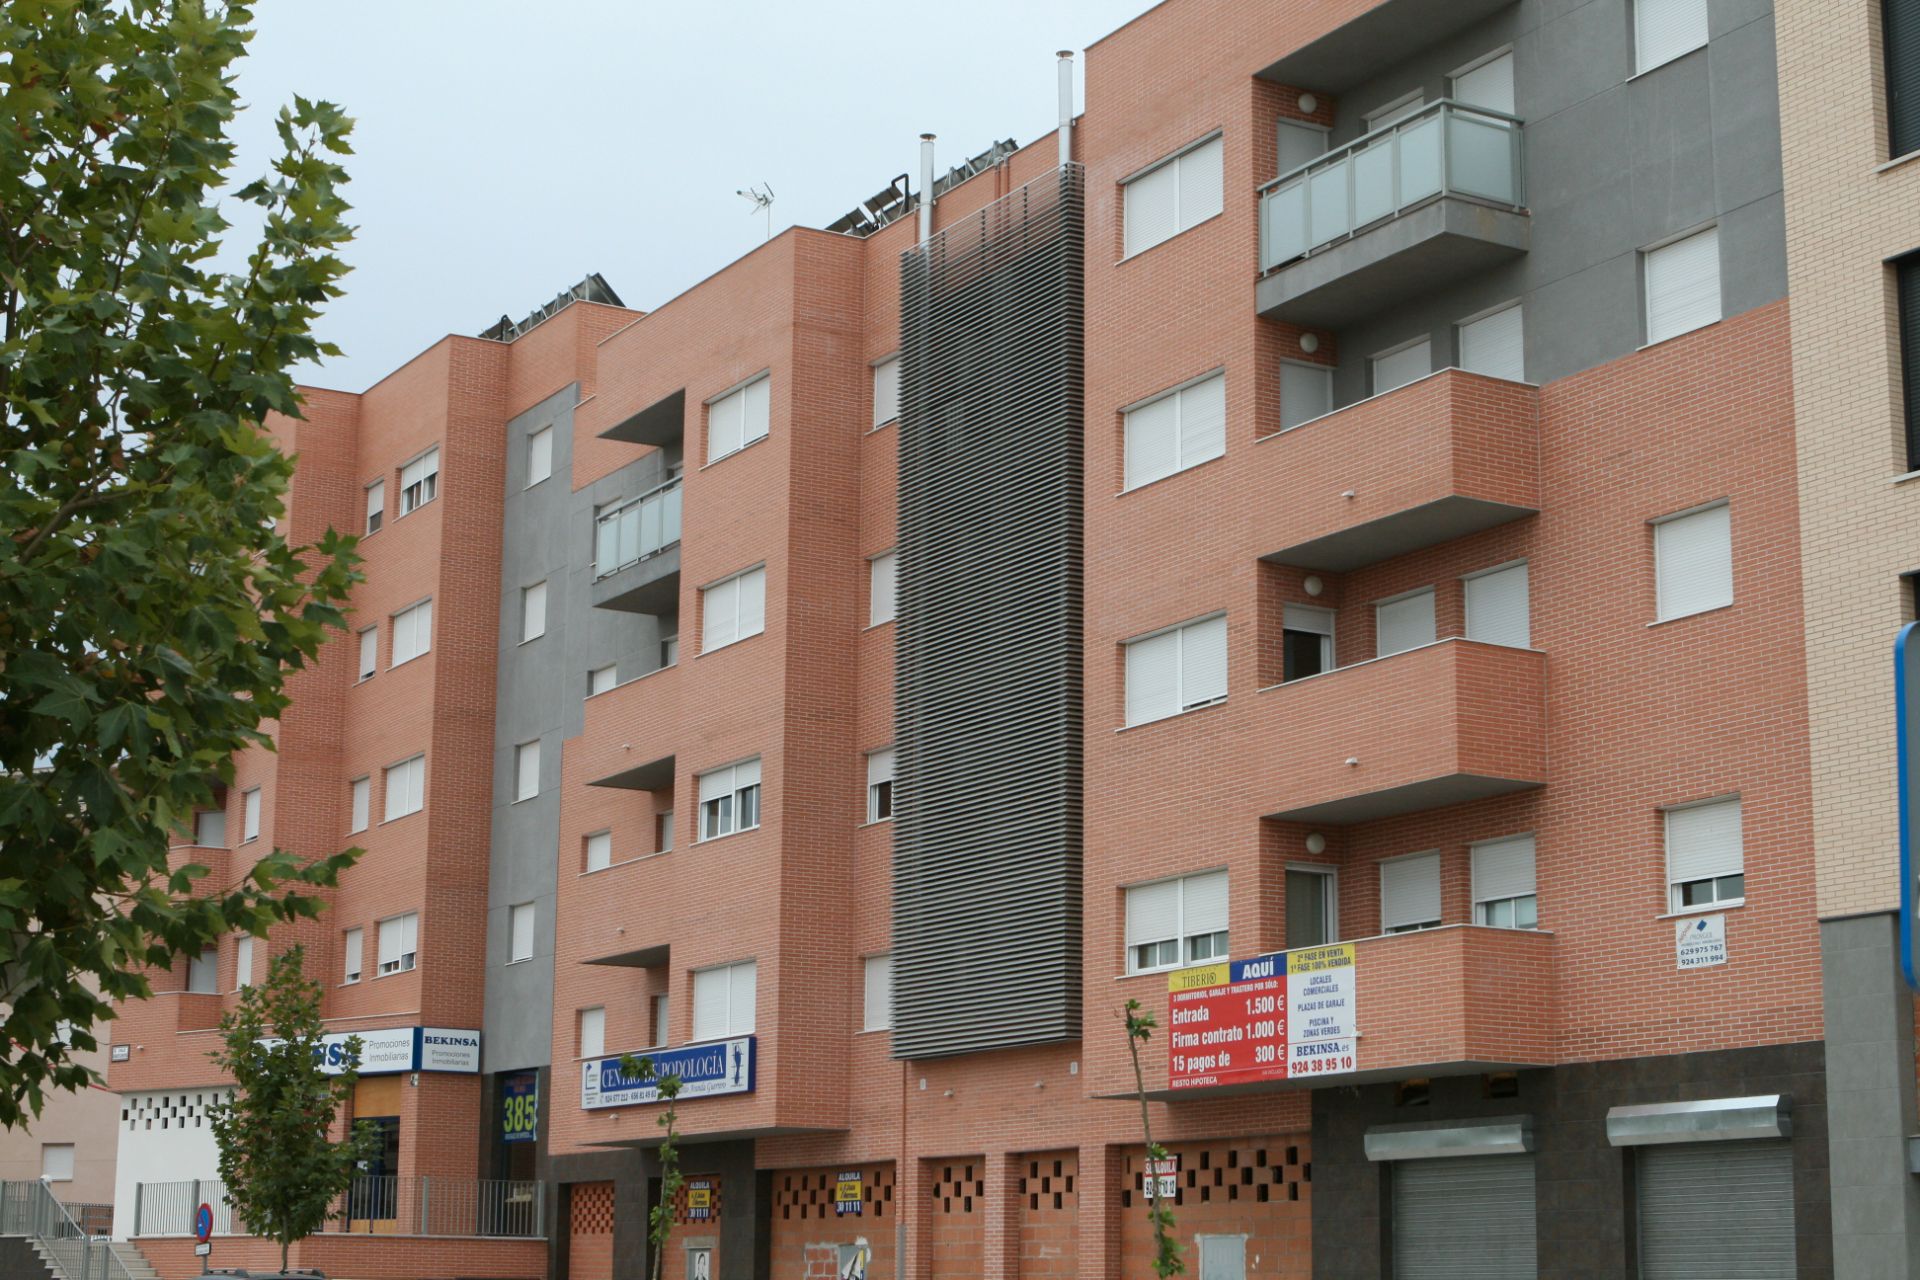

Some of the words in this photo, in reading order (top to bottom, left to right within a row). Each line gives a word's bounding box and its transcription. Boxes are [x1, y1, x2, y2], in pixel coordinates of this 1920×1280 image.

[1304, 950, 1317, 961] FASE
[1318, 950, 1326, 960] EN
[1326, 947, 1344, 959] VENTA
[1242, 957, 1274, 979] AQUÍ
[1297, 962, 1310, 973] FASE
[1311, 960, 1327, 971] 100%
[1327, 956, 1351, 968] VENDIDA
[1310, 974, 1332, 986] LOCALES
[1210, 987, 1226, 998] GARAJE
[1231, 983, 1254, 994] TRASTERO
[1254, 982, 1264, 991] POR
[1303, 984, 1339, 996] COMERCIALES
[1172, 1005, 1209, 1025] Entrada
[1246, 996, 1275, 1015] 1.500
[1277, 994, 1285, 1011] €
[1297, 1001, 1317, 1012] PLAZAS
[1317, 1000, 1324, 1010] DE
[1325, 998, 1345, 1009] GARAJE
[1309, 1017, 1329, 1027] PISCINA
[1330, 1016, 1334, 1024] Y
[1172, 1031, 1199, 1049] Firma
[1202, 1025, 1243, 1045] contrato
[1246, 1020, 1275, 1040] 1.000
[1277, 1019, 1285, 1036] €
[1303, 1028, 1320, 1038] ZONAS
[1320, 1025, 1341, 1036] VERDES
[369, 1039, 410, 1051] Promociones
[424, 1035, 478, 1047] BEKINSA
[370, 1052, 409, 1062] Inmobiliarias
[432, 1049, 470, 1058] Promociones
[1172, 1055, 1185, 1072] 15
[1187, 1055, 1216, 1074] pagos
[1218, 1050, 1231, 1067] de
[1255, 1044, 1275, 1063] 300
[1277, 1044, 1285, 1061] €
[432, 1058, 470, 1066] Inmobiliarias
[661, 1049, 724, 1079] PODOLOGÍA
[1291, 1060, 1309, 1074] 924
[1311, 1059, 1323, 1072] 38
[1325, 1057, 1337, 1071] 95
[1341, 1055, 1352, 1069] 10
[1172, 1078, 1190, 1088] RESTO
[1190, 1076, 1218, 1087] HIPOTECA
[503, 1094, 535, 1133] 385
[838, 1171, 860, 1181] ALQUILA
[689, 1181, 710, 1190] ALQUILA
